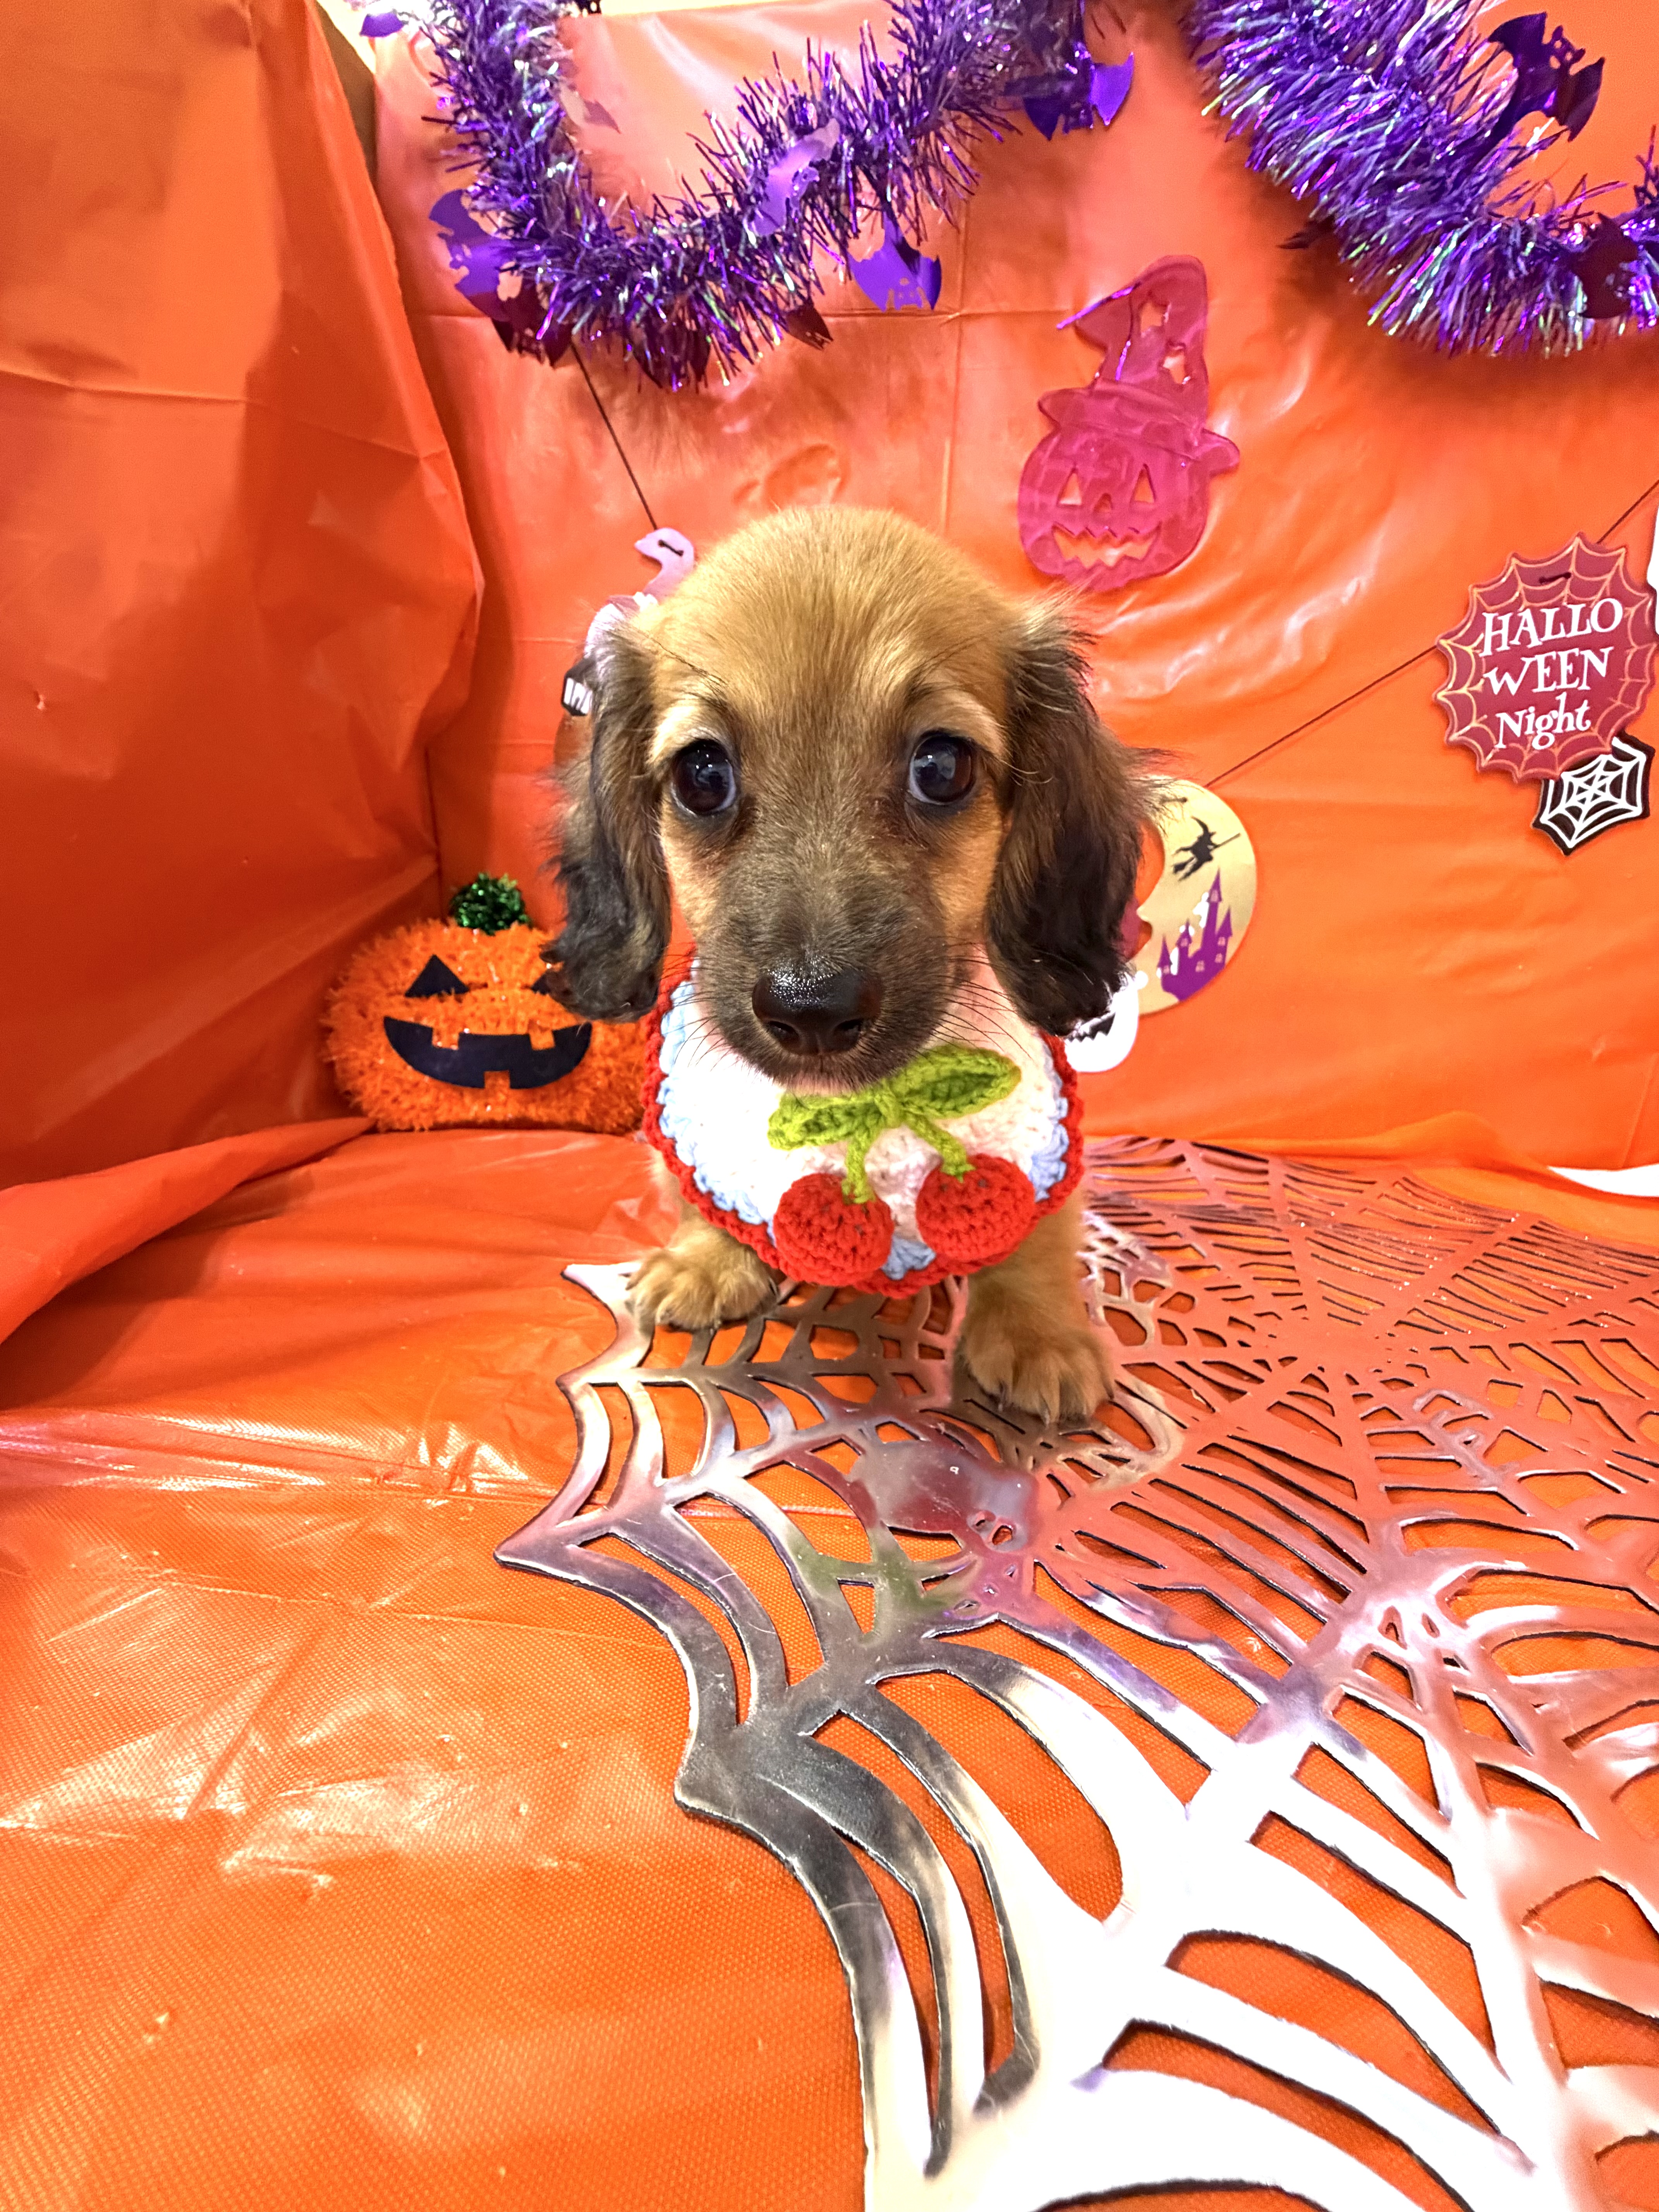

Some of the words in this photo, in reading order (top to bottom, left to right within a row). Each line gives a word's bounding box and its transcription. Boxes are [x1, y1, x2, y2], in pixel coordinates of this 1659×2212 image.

[1479, 598, 1623, 657] HALLO
[1484, 646, 1614, 695] WEEN
[1495, 692, 1591, 750] Night
